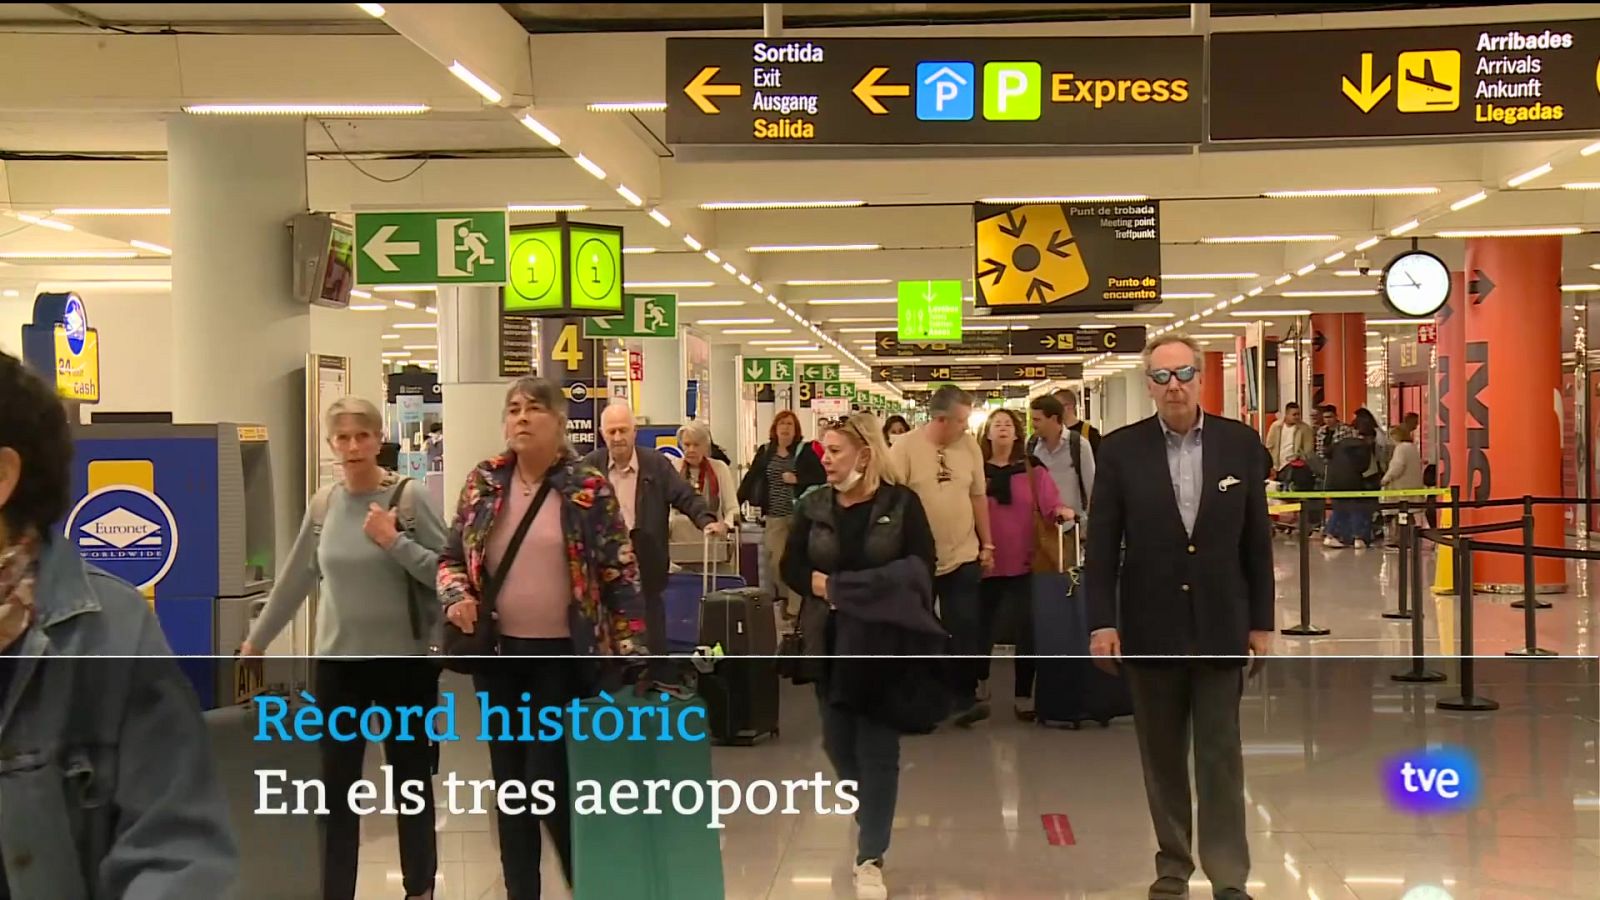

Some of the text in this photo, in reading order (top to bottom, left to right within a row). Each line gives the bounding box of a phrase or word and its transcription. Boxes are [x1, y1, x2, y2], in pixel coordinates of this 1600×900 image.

[1476, 31, 1573, 52] Arribades
[753, 43, 823, 63] Sortida
[1476, 55, 1541, 76] Arrivals
[753, 68, 781, 88] Exit
[1051, 73, 1188, 108] Express
[1476, 78, 1541, 99] Ankunft
[752, 90, 818, 115] Ausgang
[1475, 103, 1564, 125] Llegadas
[753, 119, 814, 139] Salida
[1070, 205, 1155, 216] Punt de trobada
[1100, 217, 1155, 228] Meeting point
[1115, 229, 1156, 240] Treffpunkt
[1108, 276, 1156, 288] Punto de
[1103, 290, 1156, 300] encuentro
[551, 324, 584, 371] 4
[1103, 332, 1117, 349] C
[799, 382, 811, 401] 3
[565, 419, 592, 432] ATM
[95, 522, 148, 534] Euronet
